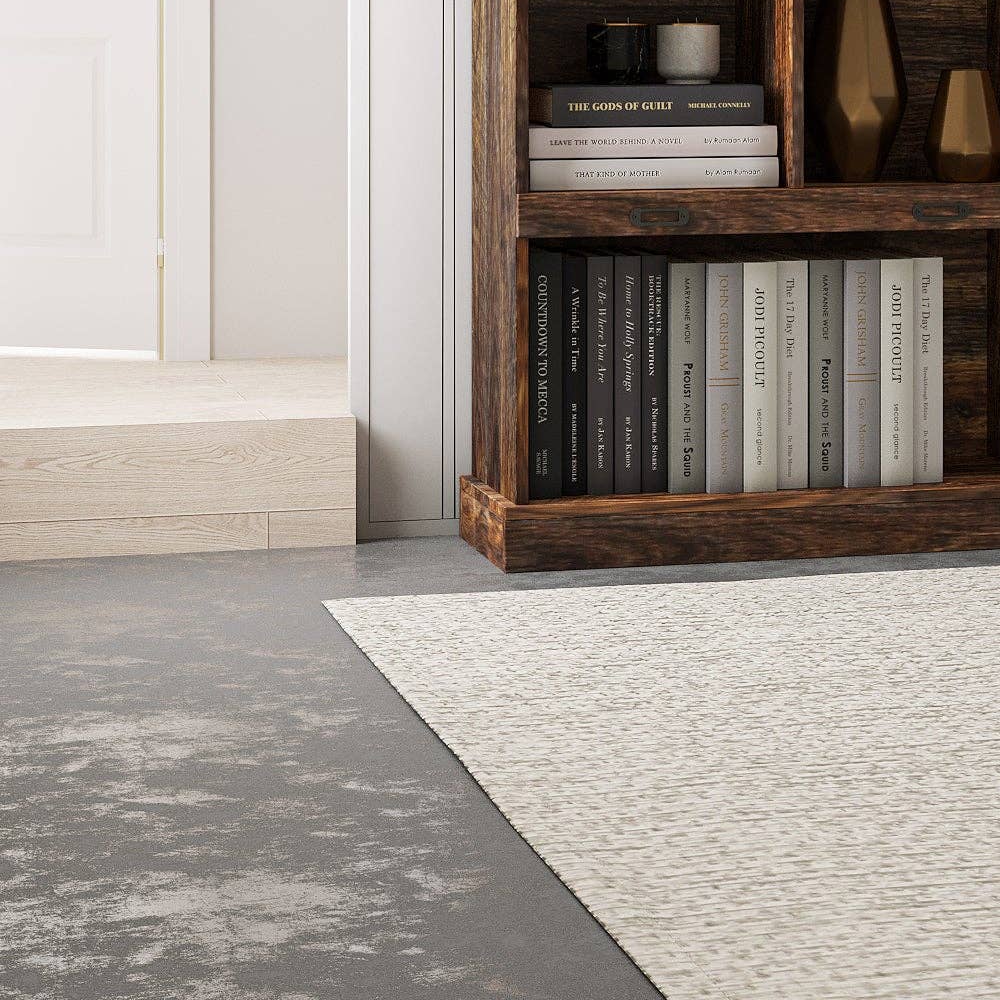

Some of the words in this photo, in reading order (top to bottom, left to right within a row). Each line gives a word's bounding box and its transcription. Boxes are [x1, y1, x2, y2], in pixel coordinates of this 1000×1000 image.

[568, 103, 590, 111] THE
[592, 102, 622, 111] GODS
[625, 102, 639, 110] OF
[642, 102, 673, 110] GUILT
[598, 277, 606, 288] To
[625, 275, 634, 304] Home
[719, 274, 728, 308] JOHN
[786, 278, 794, 297] The
[856, 271, 866, 304] JOHN
[921, 275, 930, 294] The
[598, 291, 606, 304] Be
[754, 288, 764, 321] JODI
[786, 301, 794, 312] 17
[892, 284, 901, 317] JODI
[921, 297, 930, 307] 17
[537, 275, 547, 357] COUNTDOWN
[571, 297, 579, 334] Wrinkle
[598, 308, 606, 340] Where
[626, 308, 633, 318] to
[784, 315, 794, 334] Day
[920, 311, 930, 330] Day
[571, 337, 579, 346] in
[624, 320, 634, 349] Holly
[719, 313, 728, 371] GRISHAM
[786, 338, 794, 358] Diet
[857, 309, 866, 367] GRISHAM
[921, 334, 930, 354] Diet
[571, 350, 579, 372] Time
[598, 344, 606, 361] You
[754, 327, 764, 388] PICOULT
[892, 322, 901, 383] PICOULT
[537, 360, 547, 376] TO
[598, 367, 606, 383] Are
[623, 352, 634, 391] Springs
[684, 363, 693, 398] PROUST
[822, 359, 831, 394] PROUST
[537, 380, 547, 424] MECCA
[683, 447, 693, 477] SQUID
[755, 439, 763, 466] glance
[821, 442, 831, 472] SQUID
